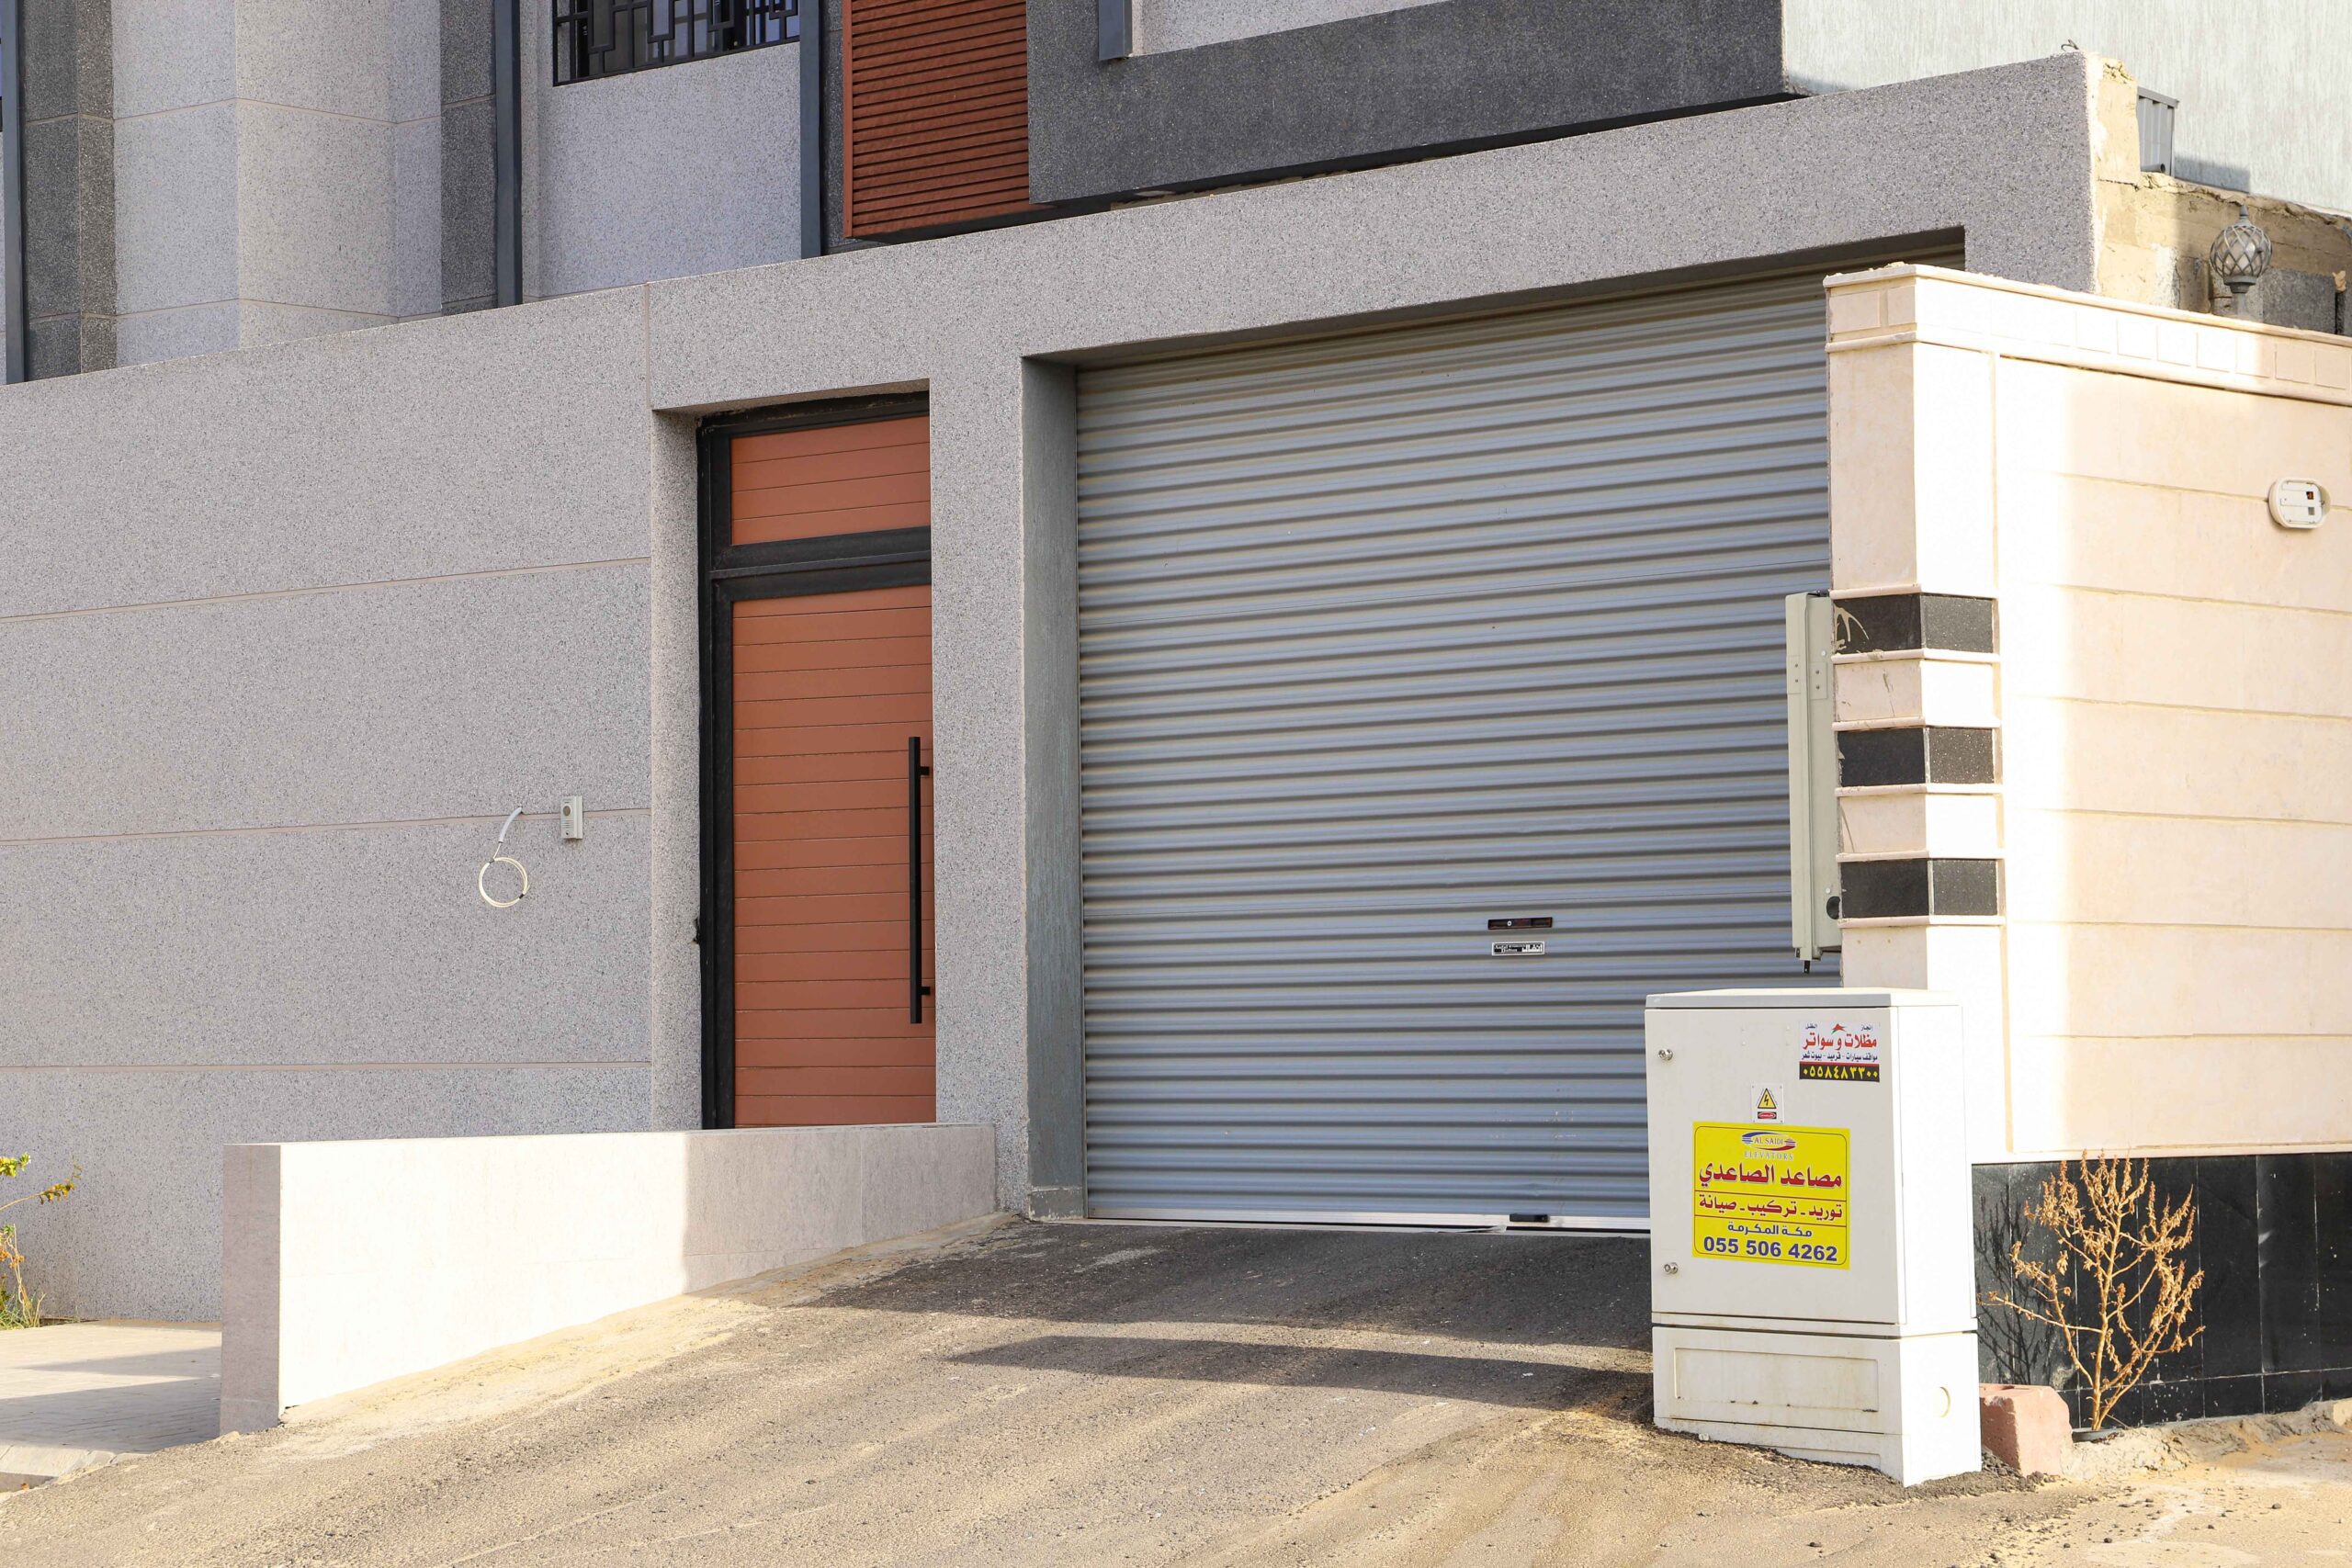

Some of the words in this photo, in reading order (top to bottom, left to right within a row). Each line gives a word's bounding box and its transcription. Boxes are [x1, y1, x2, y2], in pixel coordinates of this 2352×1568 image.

[1803, 1032, 1834, 1051] سواتر
[1844, 1032, 1877, 1049] مظلات
[1827, 1051, 1841, 1062] قرميد
[1846, 1052, 1861, 1062] سيارات
[1862, 1052, 1878, 1063] مواقف
[1745, 1150, 1793, 1161] ELEVATORS
[1699, 1161, 1774, 1188] الصاعدي
[1780, 1165, 1842, 1188] مصاعد
[1699, 1193, 1737, 1213] صيانة
[1747, 1200, 1797, 1218] تركيب
[1809, 1203, 1842, 1222] توريد
[1727, 1221, 1779, 1236] المكرمة
[1781, 1224, 1813, 1237] مكة
[1703, 1236, 1739, 1254] 055
[1746, 1240, 1781, 1258] 506
[1788, 1243, 1838, 1262] 4262
